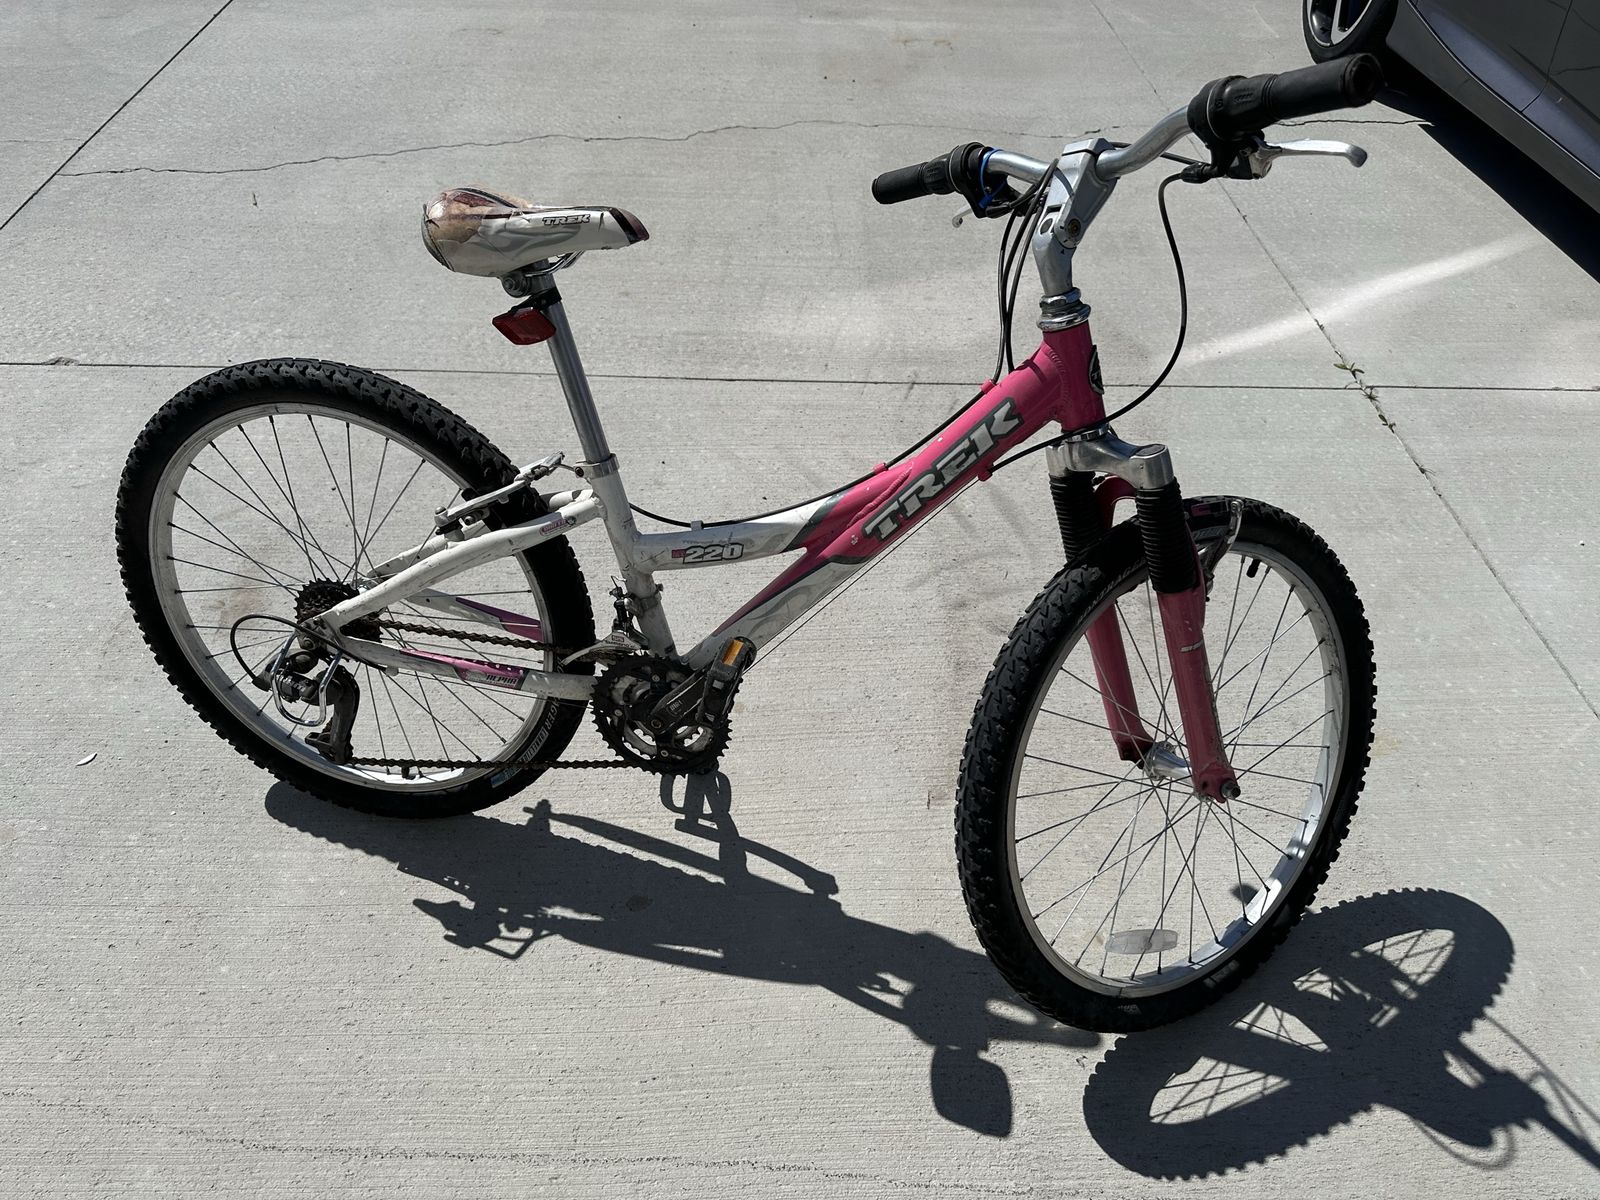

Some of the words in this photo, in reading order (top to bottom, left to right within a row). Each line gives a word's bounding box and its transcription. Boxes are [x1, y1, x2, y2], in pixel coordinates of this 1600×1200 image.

[542, 214, 591, 226] TREK
[862, 398, 1023, 541] TREK
[683, 542, 744, 564] 220
